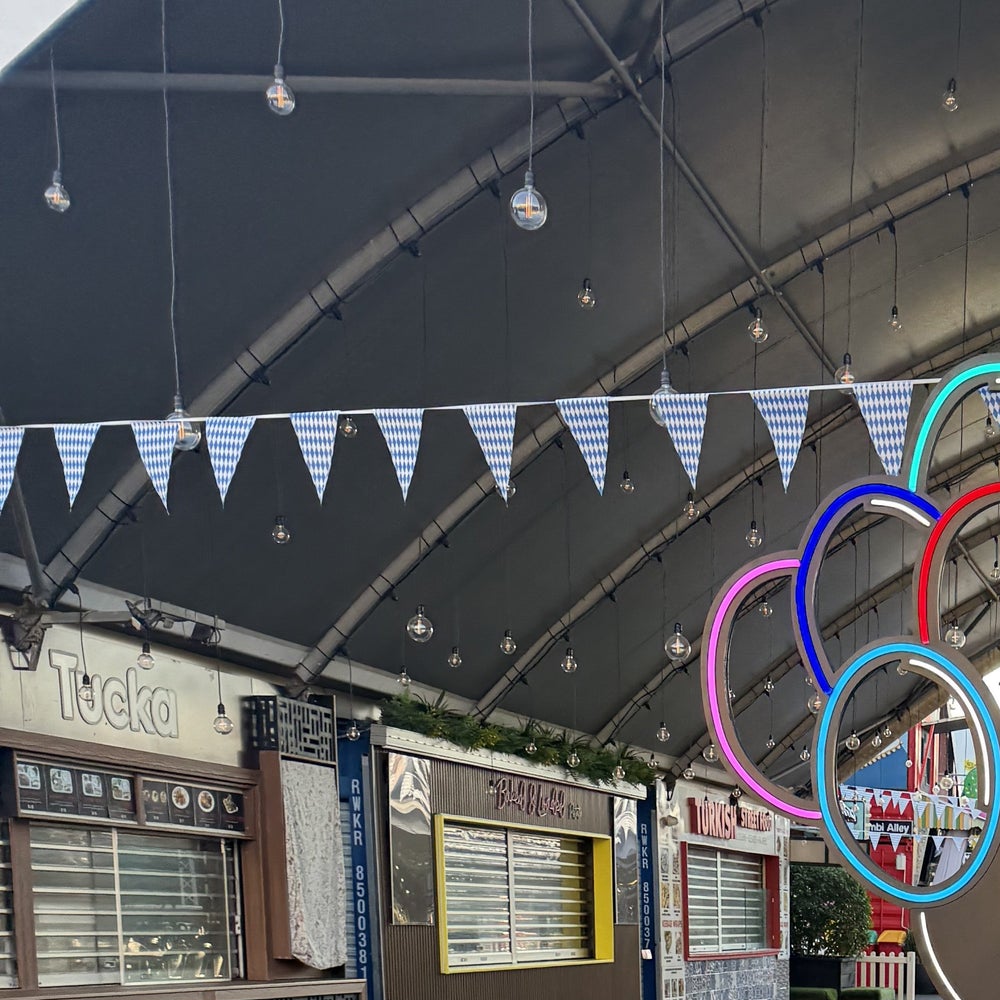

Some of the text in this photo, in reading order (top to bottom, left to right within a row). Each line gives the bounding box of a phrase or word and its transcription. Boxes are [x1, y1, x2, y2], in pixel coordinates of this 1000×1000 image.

[48, 648, 179, 739] Tucka
[351, 778, 363, 846] RWKR
[741, 806, 760, 830] STREET
[887, 823, 910, 833] Alley
[640, 823, 650, 949] RWKR 850037
